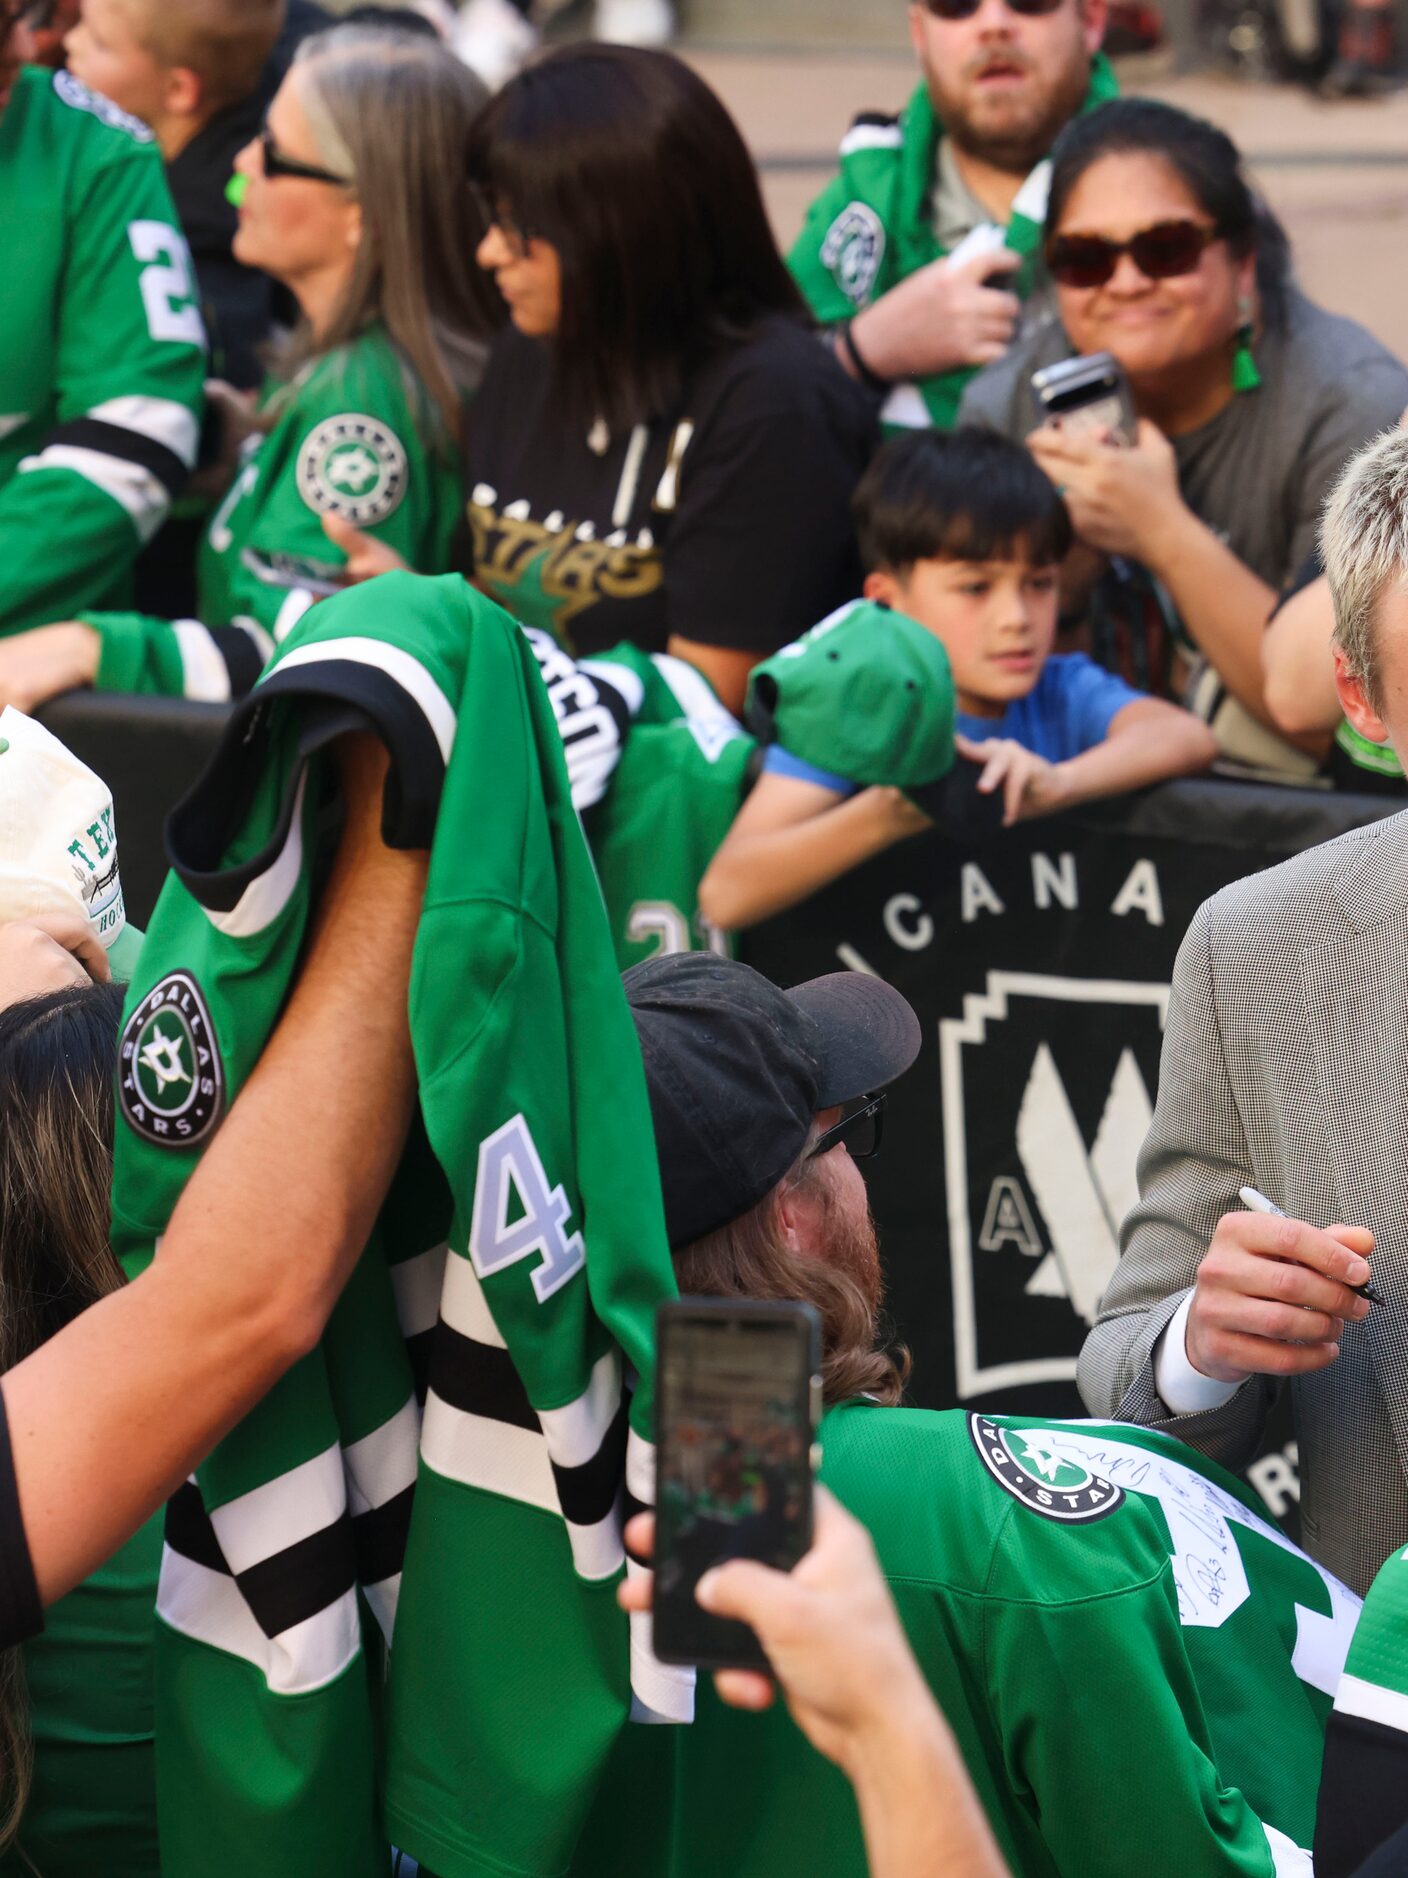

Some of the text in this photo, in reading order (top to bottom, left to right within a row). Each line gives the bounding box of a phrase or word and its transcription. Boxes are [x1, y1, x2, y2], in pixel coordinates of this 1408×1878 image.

[126, 219, 209, 346] 2
[121, 1041, 192, 1136] STARS
[150, 985, 214, 1096] DALLAS
[468, 1112, 586, 1304] 4
